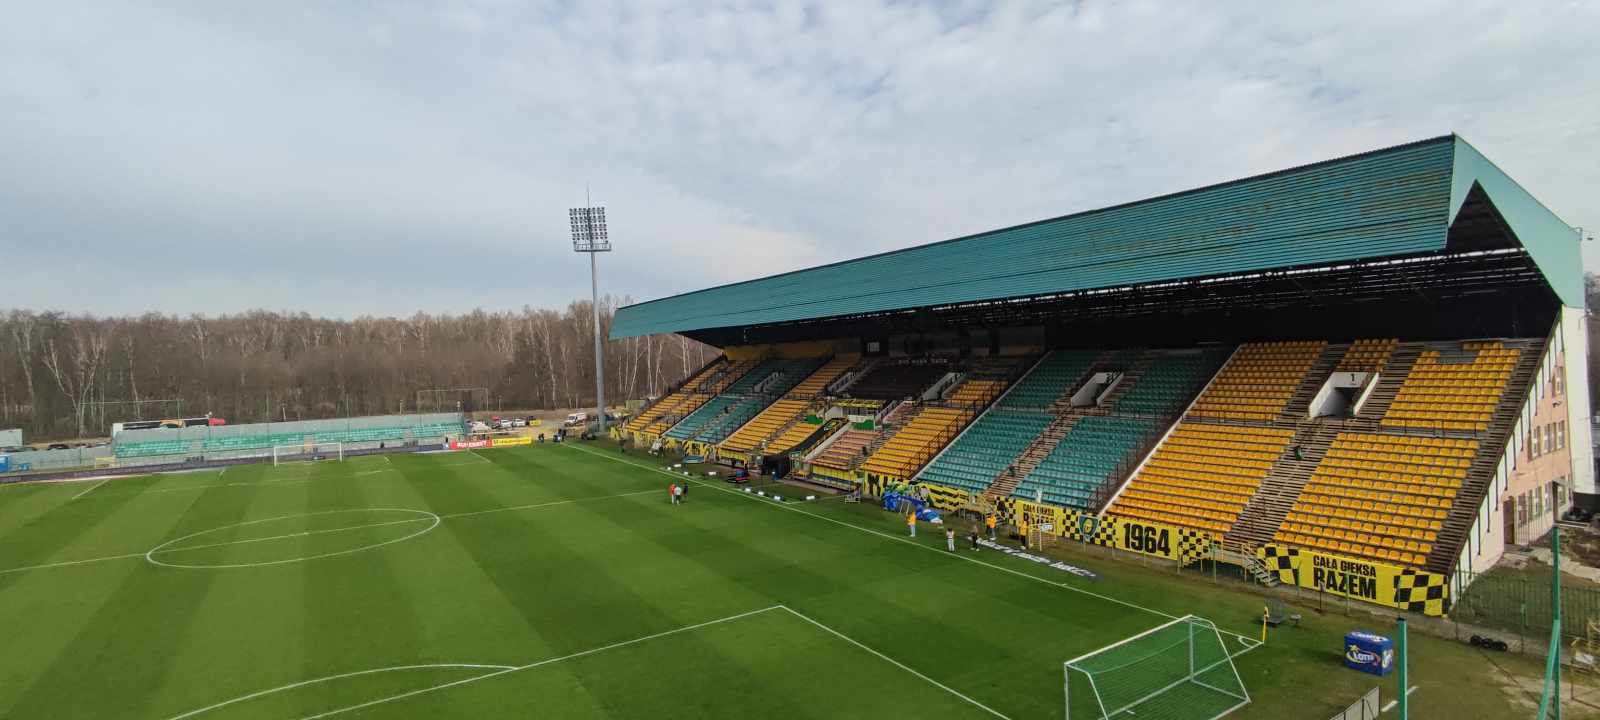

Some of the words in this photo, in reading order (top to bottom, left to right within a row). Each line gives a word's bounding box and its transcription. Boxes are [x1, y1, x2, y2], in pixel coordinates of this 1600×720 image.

[1123, 522, 1171, 556] 1964
[1313, 555, 1338, 570] CAŁA
[1340, 559, 1377, 578] GIEKSA
[1313, 568, 1377, 600] RAZEM
